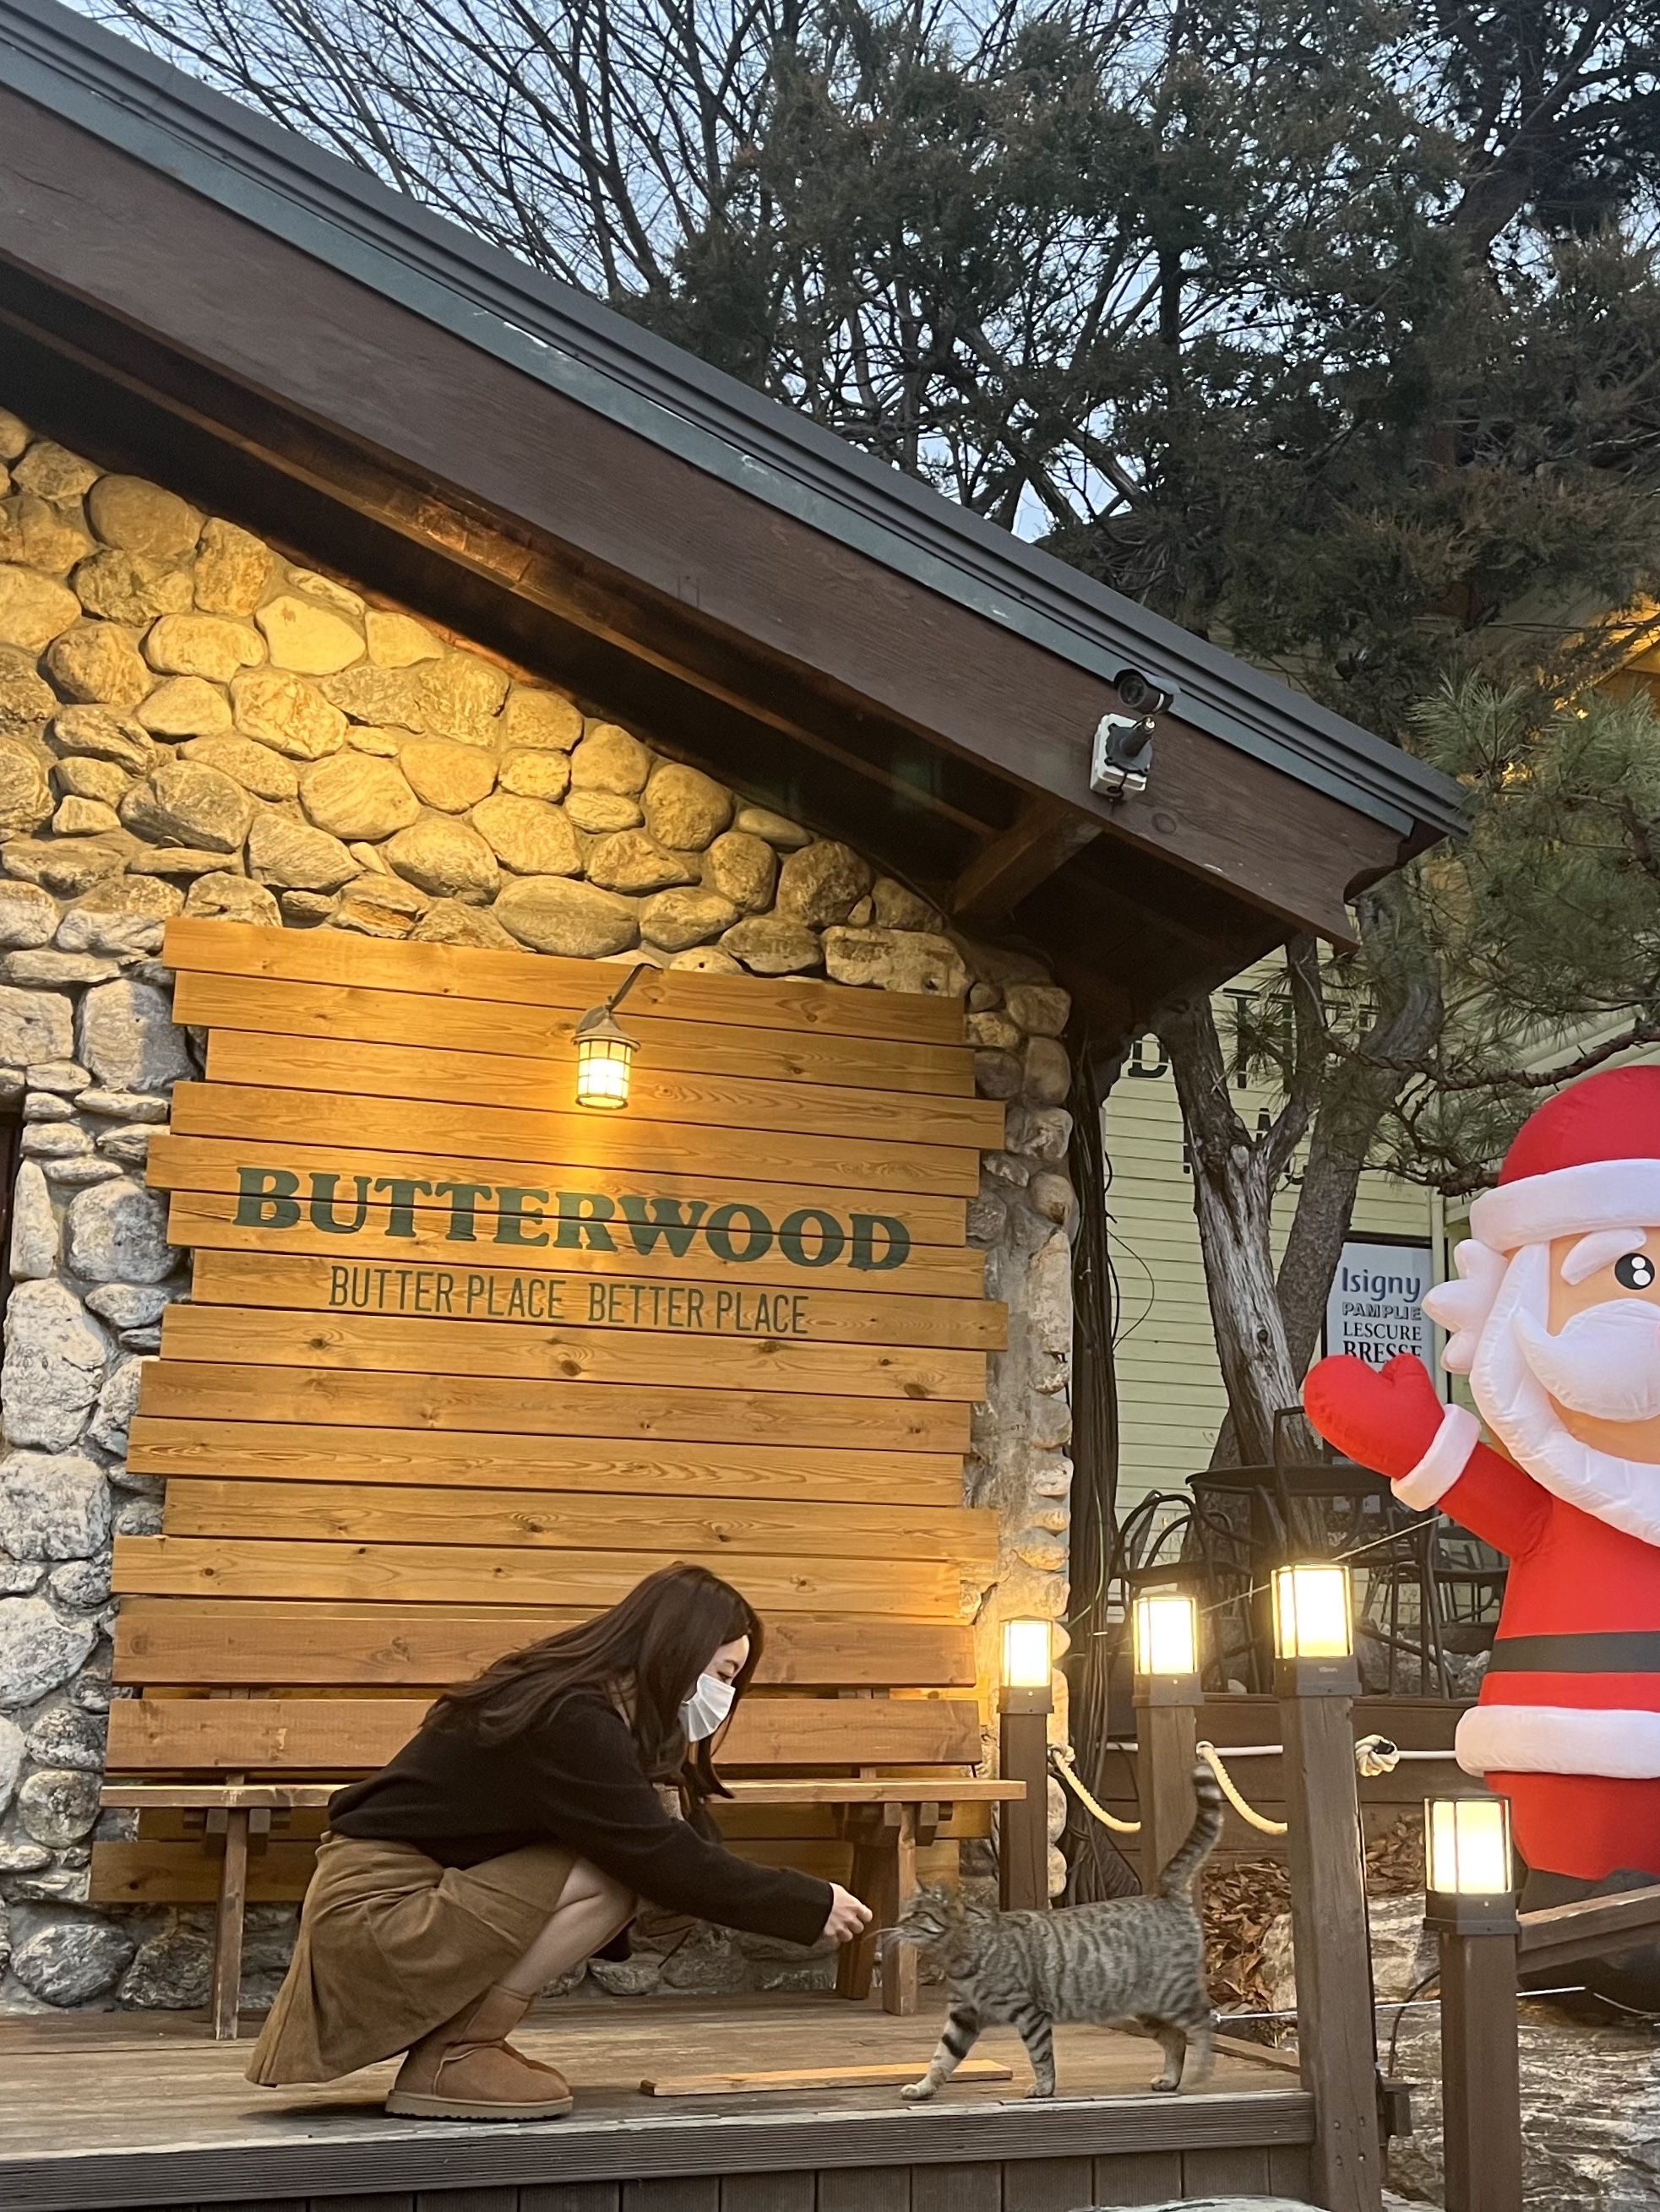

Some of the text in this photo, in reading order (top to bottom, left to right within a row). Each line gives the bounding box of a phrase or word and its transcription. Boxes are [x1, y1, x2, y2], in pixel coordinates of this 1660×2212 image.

[232, 1166, 912, 1271] BUTTERWOOD
[328, 1265, 809, 1334] BUTTER PLACE BETTER PLACE
[1342, 1267, 1421, 1303] Isigny
[1342, 1302, 1423, 1321] PAMPLIE
[1343, 1321, 1423, 1341] LESCURE
